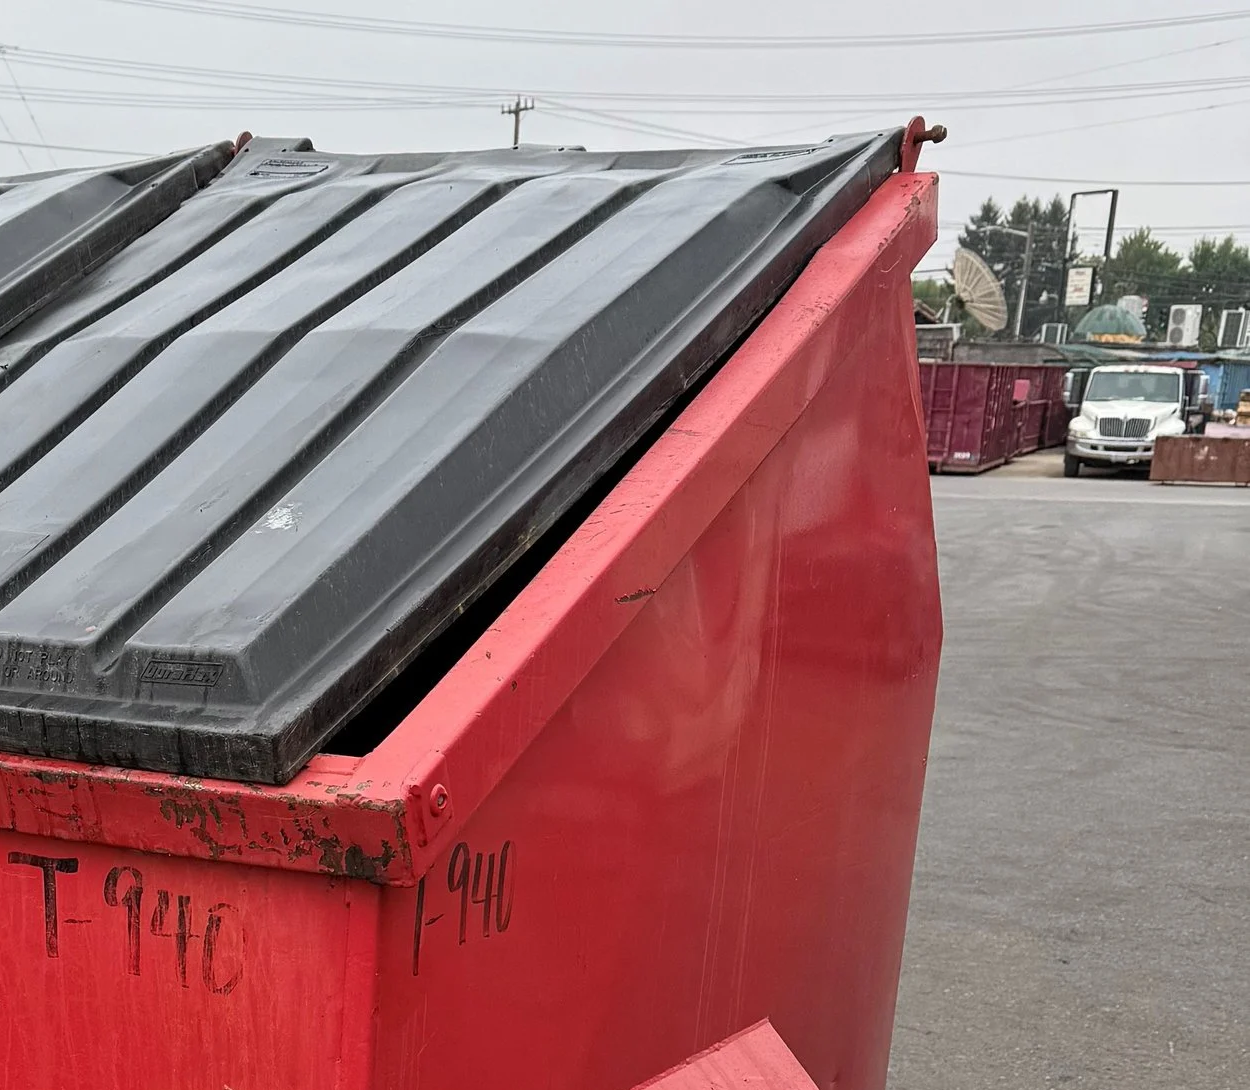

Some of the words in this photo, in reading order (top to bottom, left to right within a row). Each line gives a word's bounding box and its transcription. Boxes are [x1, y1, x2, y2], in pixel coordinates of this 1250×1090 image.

[9, 649, 34, 664] NOT
[40, 652, 73, 668] PLAY
[4, 665, 20, 679] OR
[27, 667, 75, 684] AROUND
[6, 850, 246, 997] T-940
